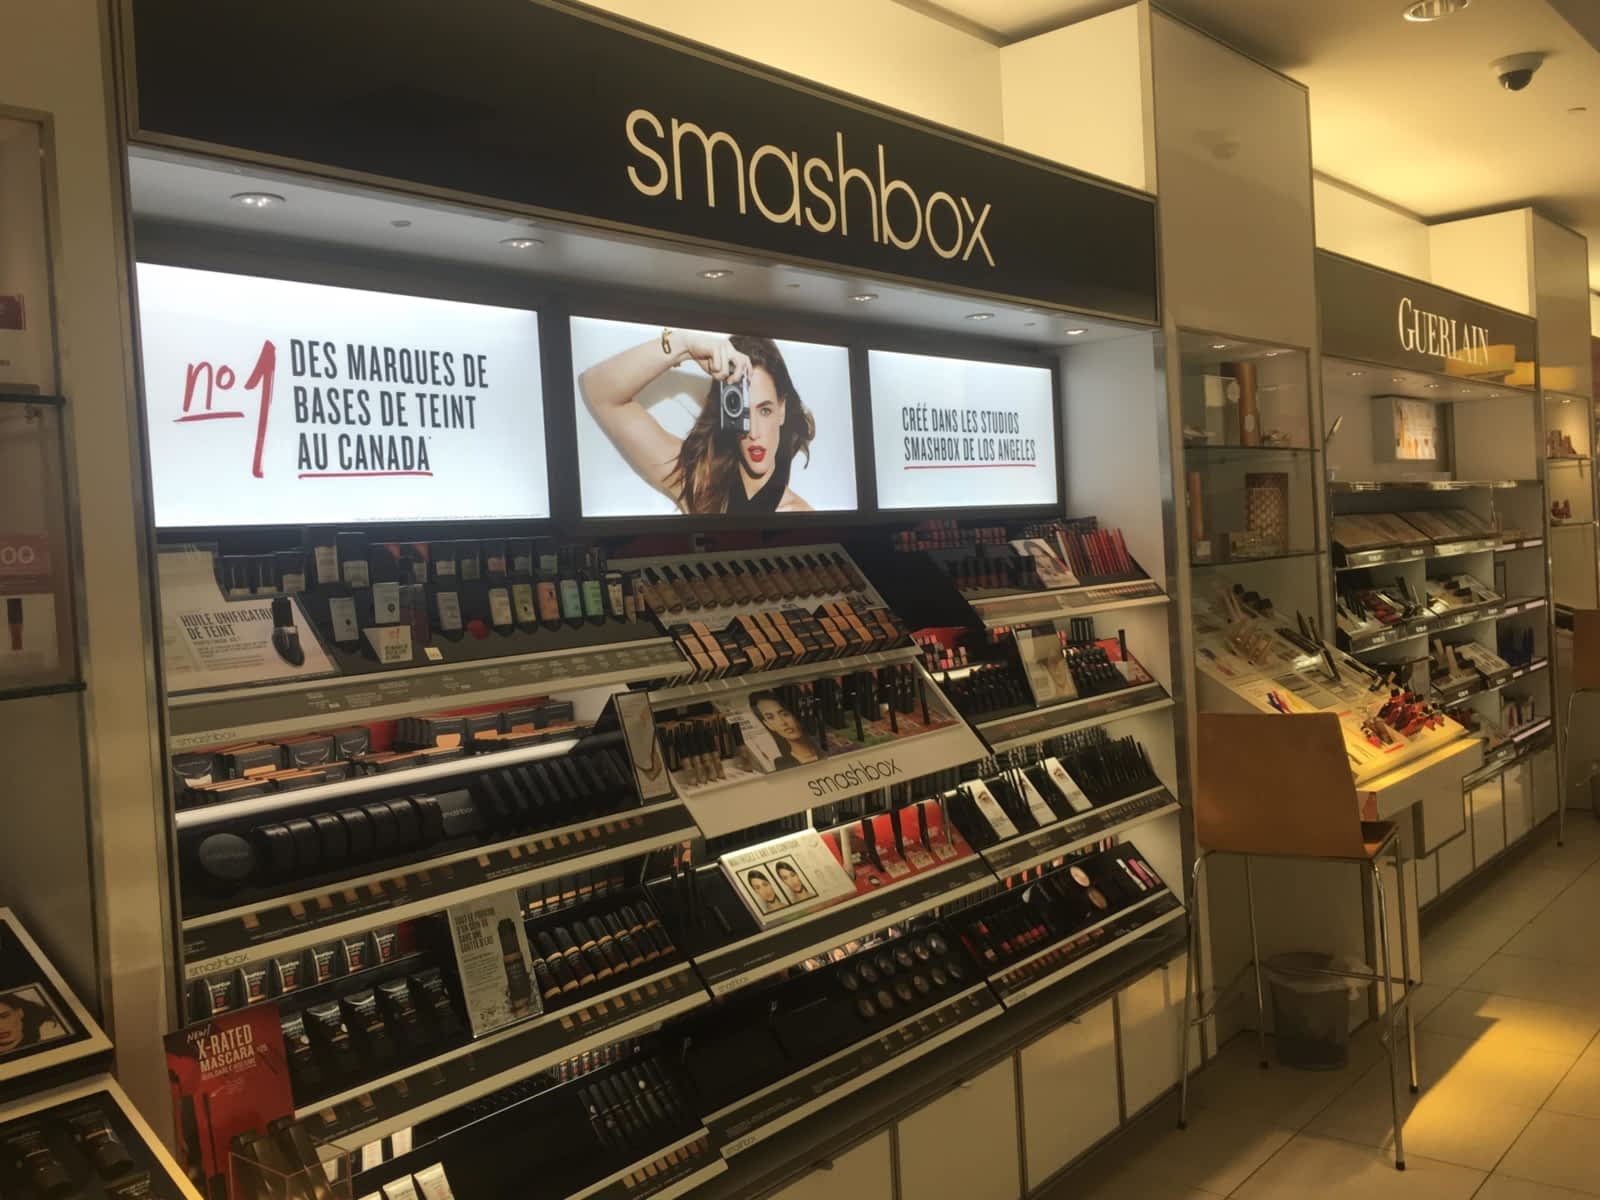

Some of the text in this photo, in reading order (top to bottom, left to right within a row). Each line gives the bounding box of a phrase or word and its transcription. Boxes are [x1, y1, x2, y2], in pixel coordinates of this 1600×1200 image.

[625, 109, 996, 267] smashbox
[1398, 297, 1489, 366] GUERLAIN
[290, 338, 489, 389] DES MARQUES DE
[293, 386, 477, 430] BASES DE TEINT
[901, 402, 1020, 434] CRÉÉ DANS LES STUDIOS
[297, 433, 329, 470] AU
[904, 437, 1037, 461] SMASHBOX DE LOS ANGELES
[180, 613, 214, 628] HUILE
[186, 624, 236, 641] DE TEINT
[807, 758, 904, 797] smashbox
[196, 1024, 254, 1060] X-RATED
[200, 1044, 255, 1073] MASCARA
